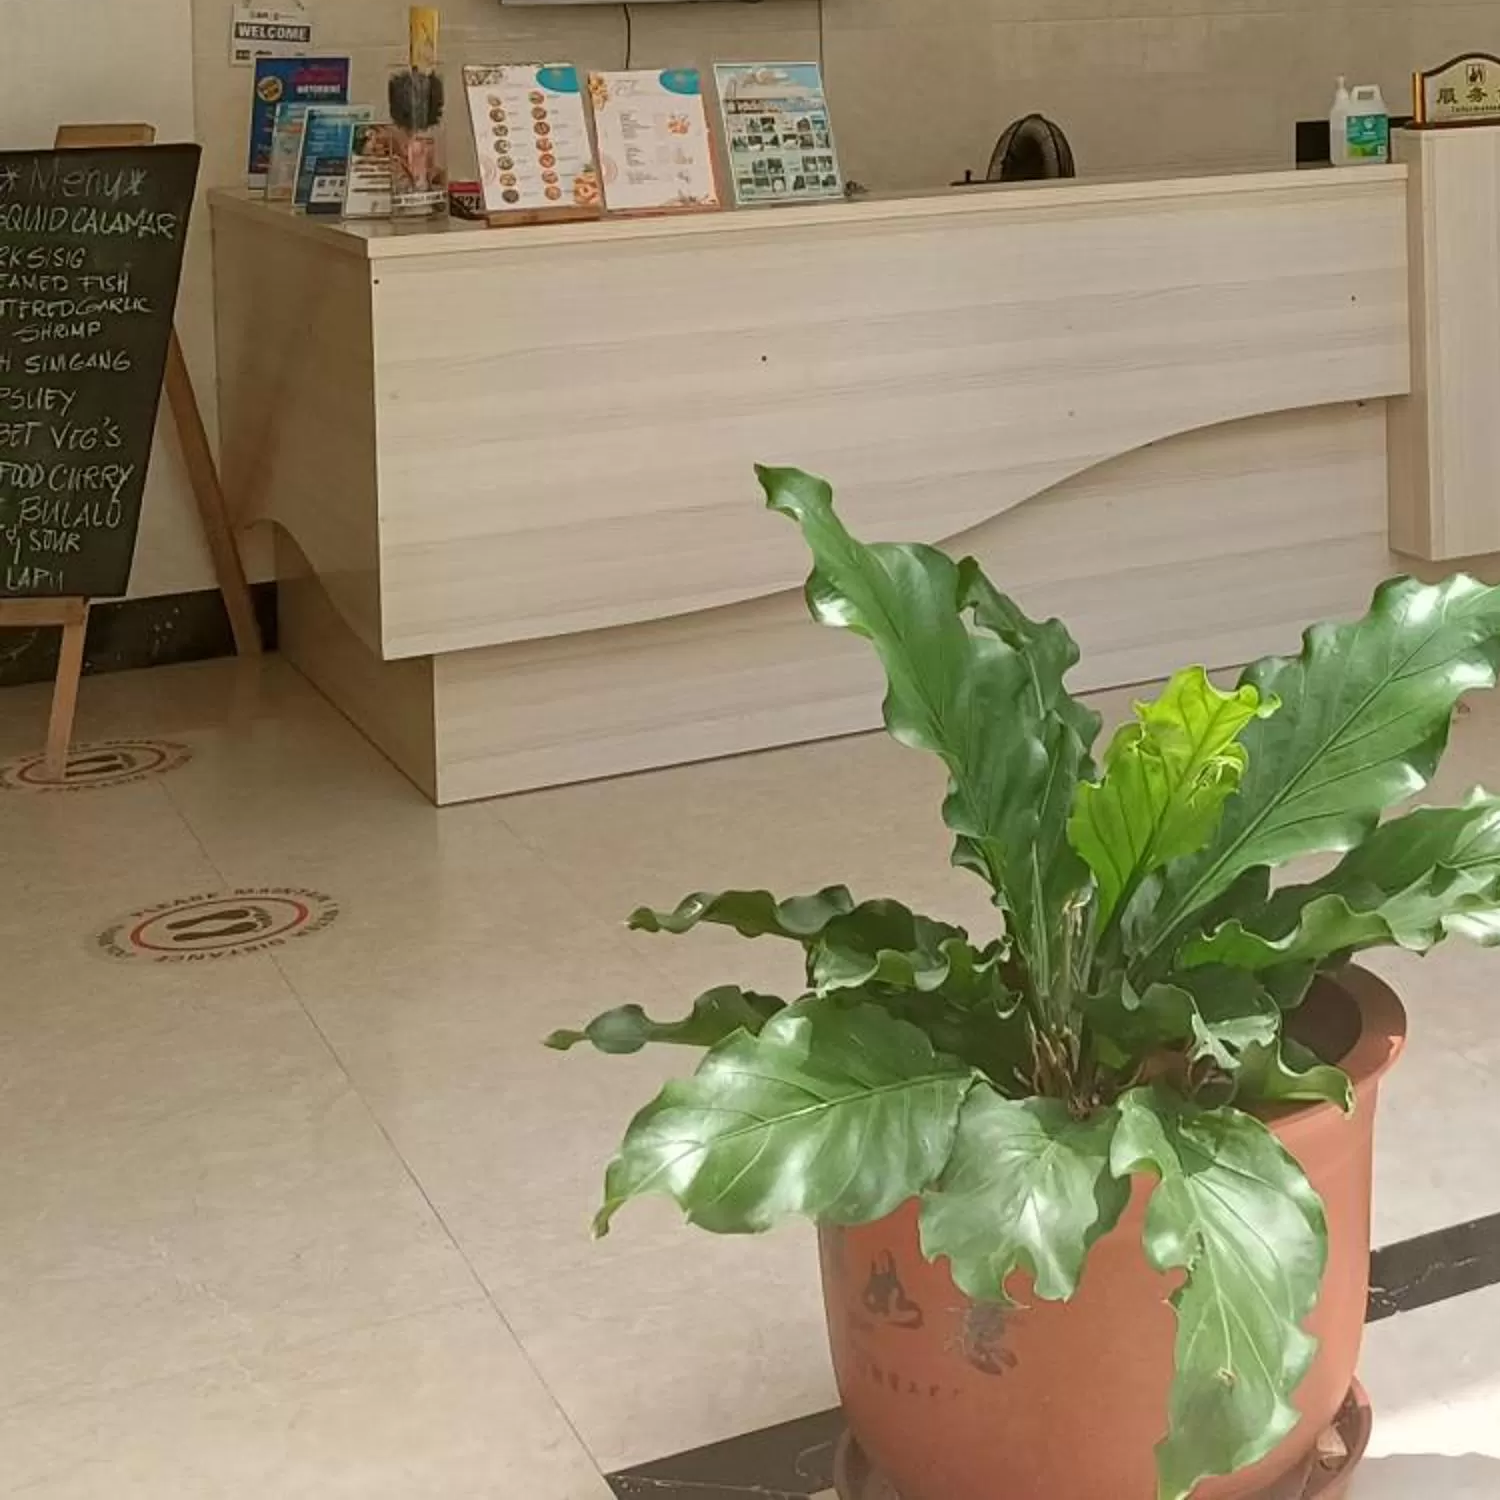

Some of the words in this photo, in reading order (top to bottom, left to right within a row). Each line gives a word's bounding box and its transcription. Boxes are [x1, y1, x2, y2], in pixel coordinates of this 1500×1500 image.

[238, 24, 308, 42] WELCOME
[27, 247, 86, 270] SISIG
[77, 271, 130, 294] FISH
[13, 321, 101, 342] SHRIMP
[48, 463, 135, 501] CURRY
[19, 495, 122, 528] BULALO
[29, 528, 81, 553] SOUR
